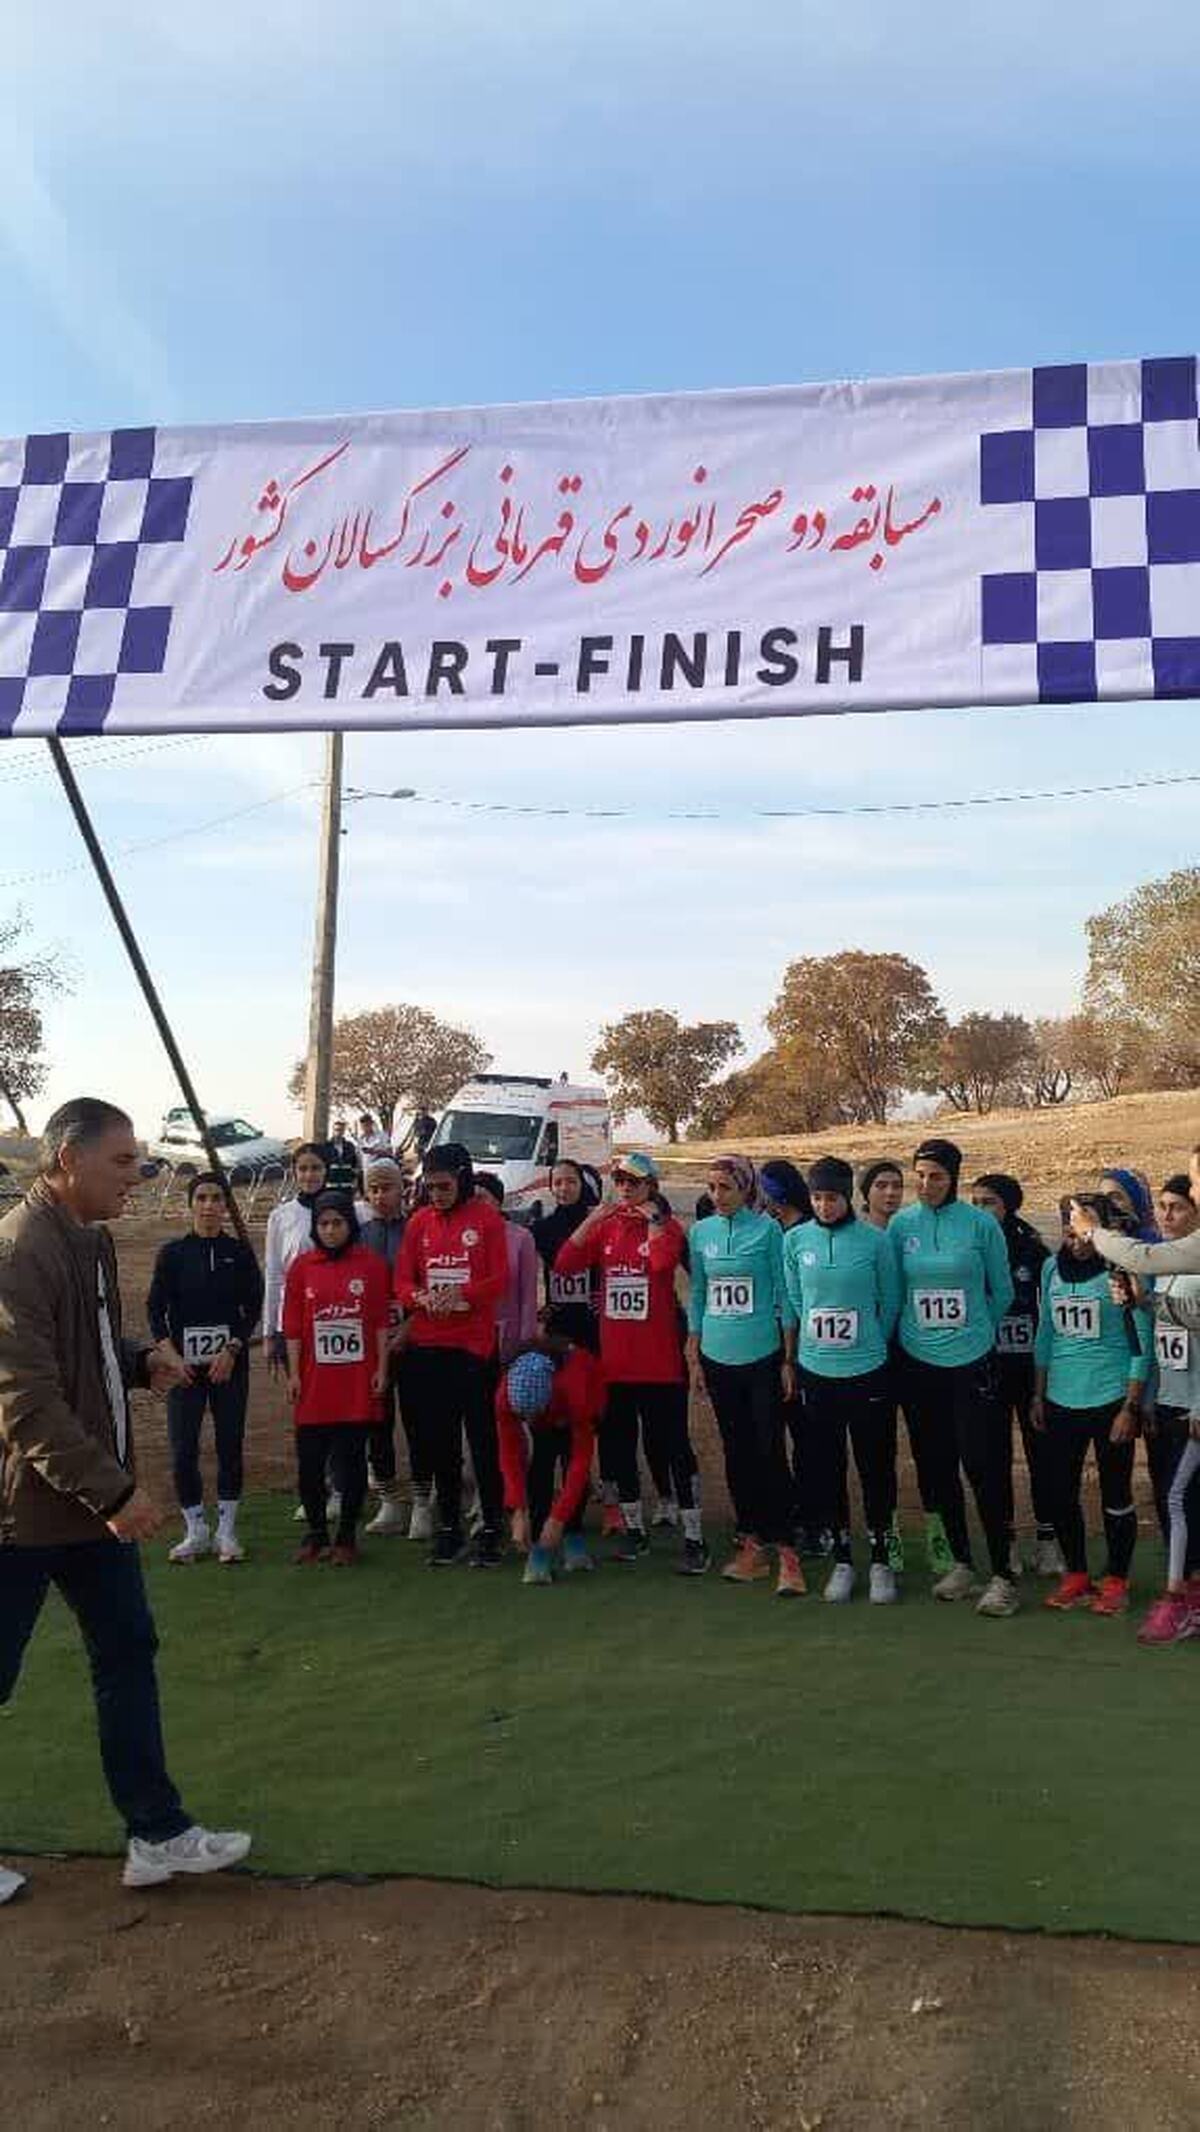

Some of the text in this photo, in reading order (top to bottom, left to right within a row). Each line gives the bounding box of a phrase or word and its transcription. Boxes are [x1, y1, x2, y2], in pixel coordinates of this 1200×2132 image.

[213, 441, 350, 571] کشور
[283, 444, 472, 598] بزرگسالان
[467, 465, 582, 586] قهرمانی
[786, 510, 826, 552] دو
[830, 484, 942, 569] مسابقه
[263, 624, 864, 700] START-FINISH
[553, 1276, 586, 1296] 101
[713, 1285, 749, 1306] 110
[610, 1291, 645, 1311] 105
[919, 1298, 961, 1320] 113
[812, 1316, 851, 1340] 112
[1055, 1305, 1093, 1330] 111
[188, 1333, 227, 1356] 122
[318, 1333, 360, 1355] 106
[998, 1324, 1029, 1344] 15
